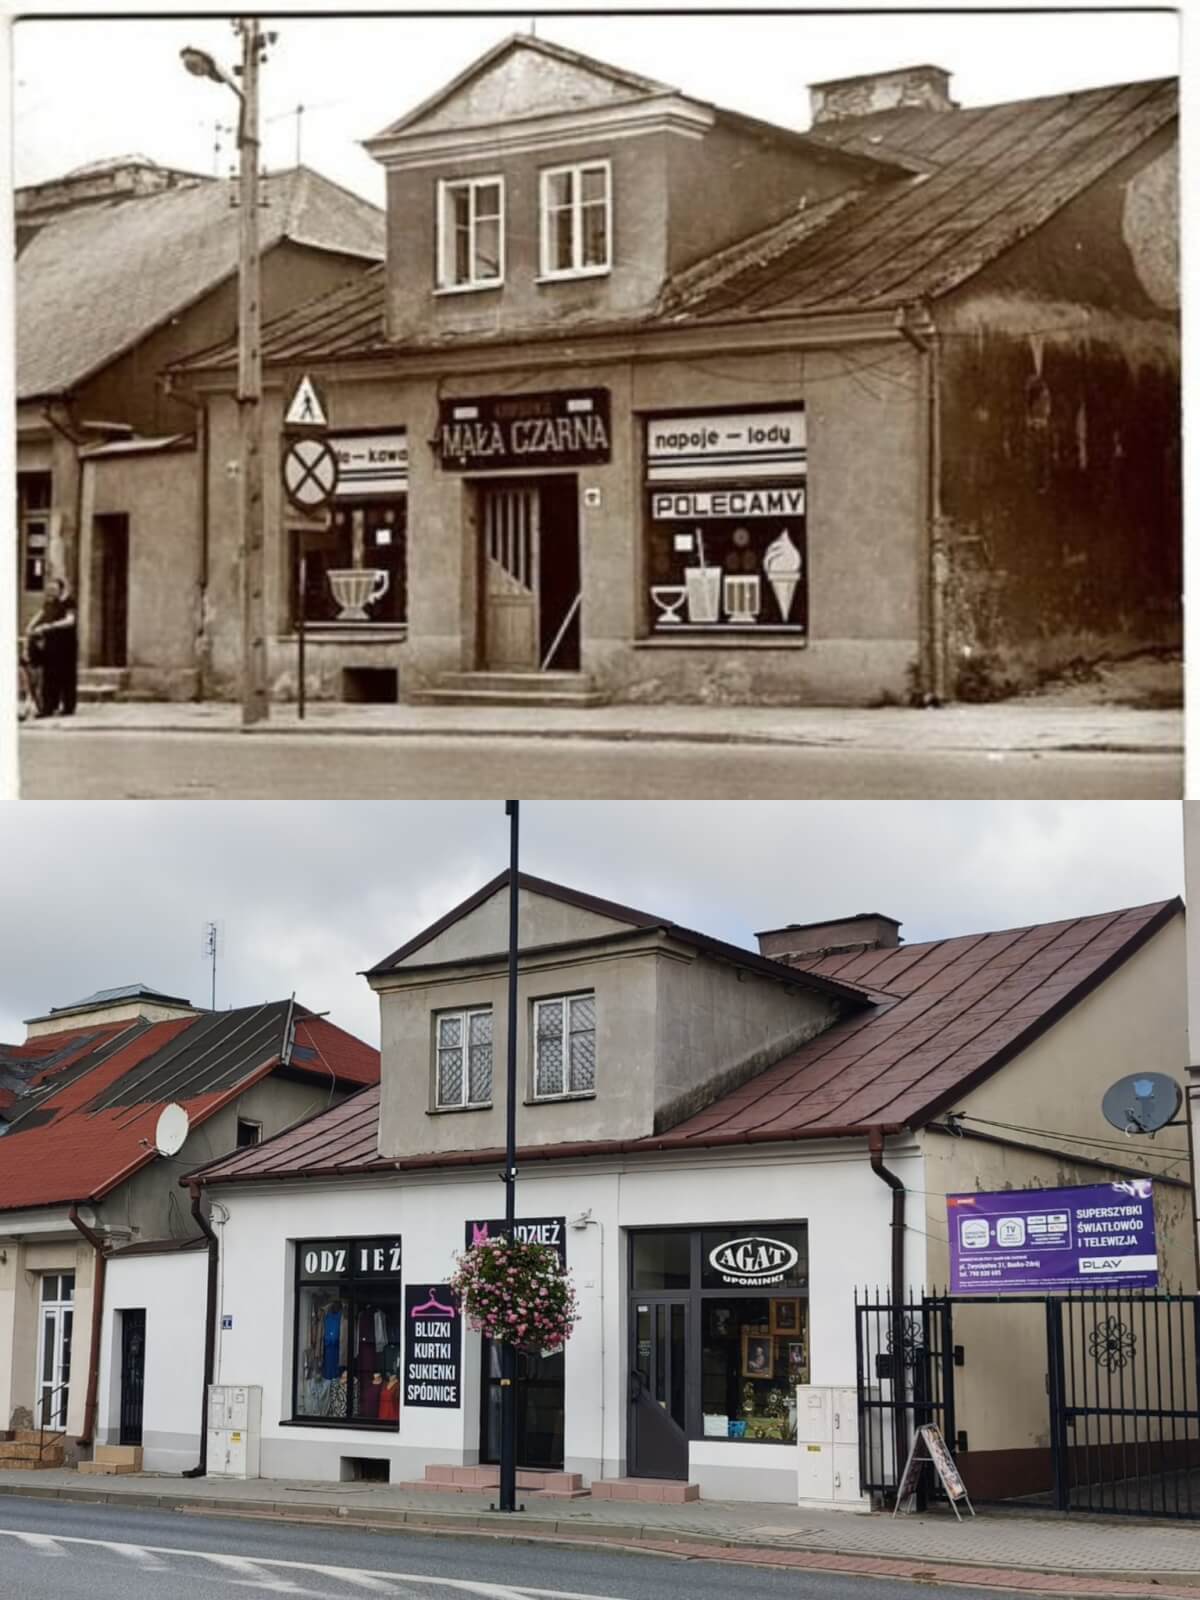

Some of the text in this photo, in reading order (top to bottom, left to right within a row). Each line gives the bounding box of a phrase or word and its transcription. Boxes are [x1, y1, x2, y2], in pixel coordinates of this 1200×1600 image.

[442, 415, 609, 458] MAŁA CZARNA
[655, 429, 719, 450] napoje
[748, 424, 791, 444] lody
[656, 493, 802, 516] POLECAMY
[1076, 1205, 1143, 1219] SUPERSZYBKI
[514, 1220, 560, 1245] DZIEŻ
[1077, 1219, 1144, 1233] ŚWIATŁOWÓD
[1084, 1235, 1138, 1247] TELEWIZJA
[719, 1244, 785, 1271] AGAT
[1082, 1260, 1122, 1270] PLAY
[722, 1274, 784, 1285] UPOMINKI
[415, 1321, 450, 1338] BLUZKI
[414, 1343, 450, 1360] KURTKI
[409, 1363, 455, 1381] SUKIENKI
[407, 1384, 456, 1402] SPÓDNICE
